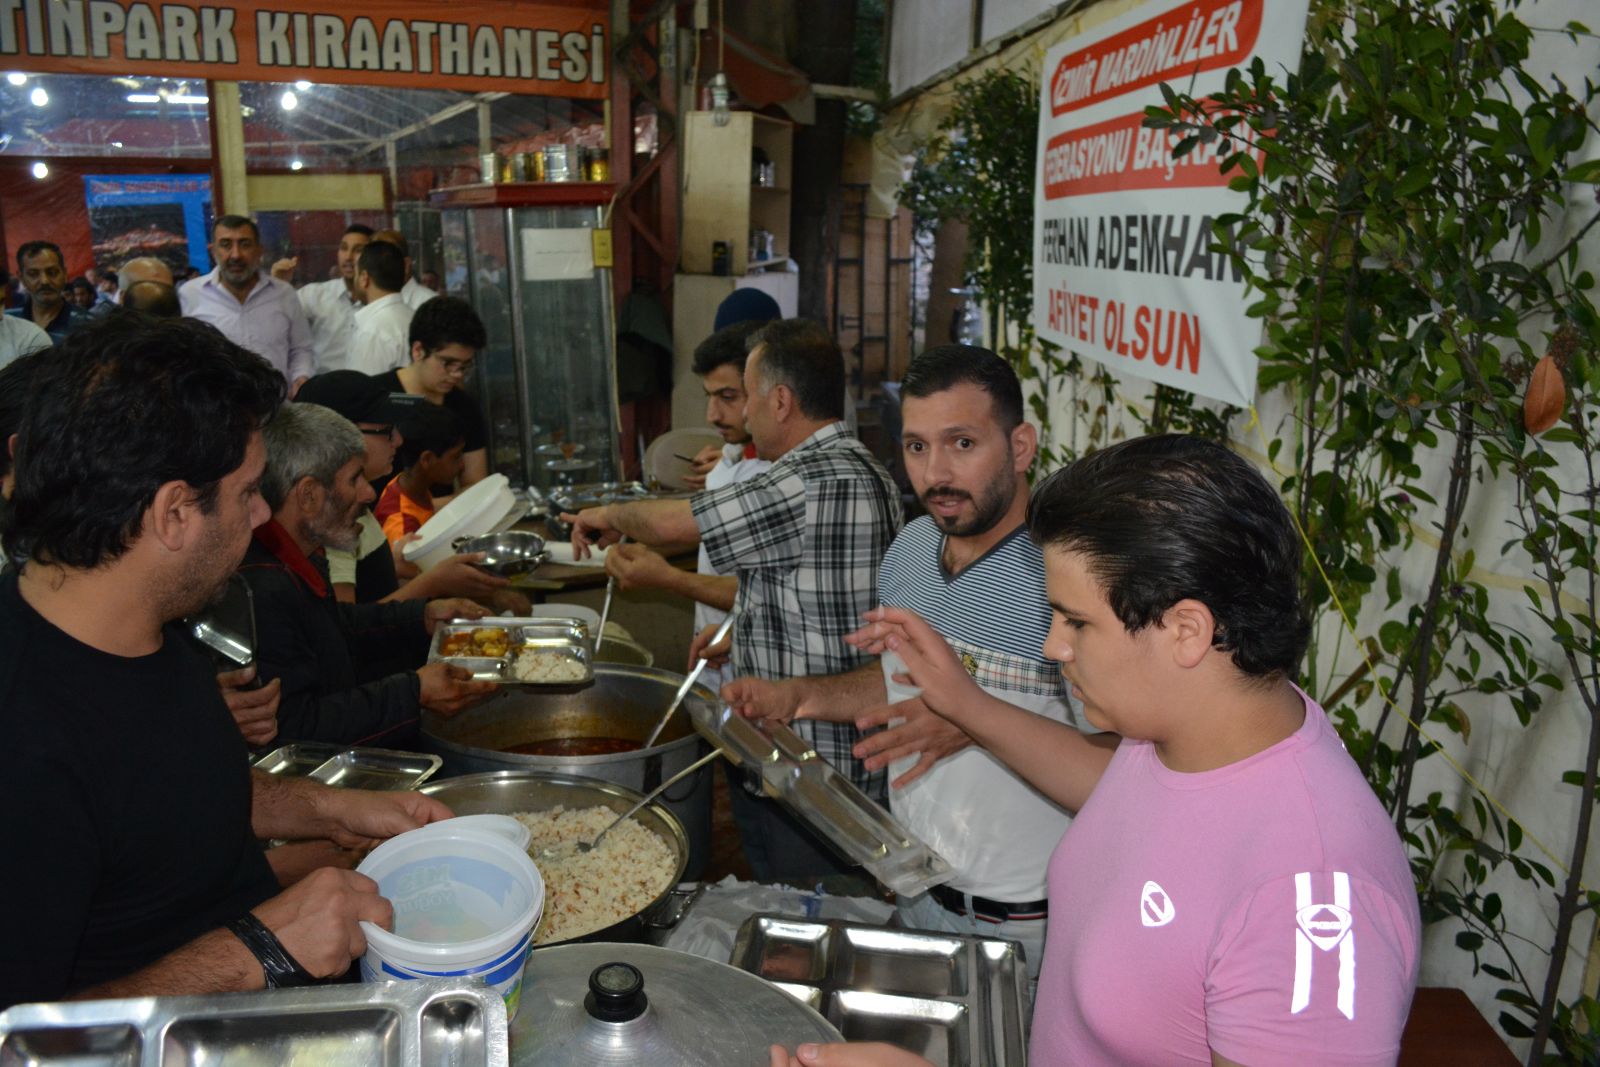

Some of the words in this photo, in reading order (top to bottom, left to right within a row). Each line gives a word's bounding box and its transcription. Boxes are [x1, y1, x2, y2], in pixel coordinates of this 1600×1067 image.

[255, 10, 605, 84] KIRAATHANESİ
[1053, 53, 1098, 108] İZMİR
[1094, 0, 1243, 94] MARDİNLİLER
[1045, 127, 1133, 186] FEDERASYONU
[1042, 216, 1089, 268] FERHAN
[1047, 280, 1099, 344] AFİYET
[1104, 300, 1201, 375] OLSUN
